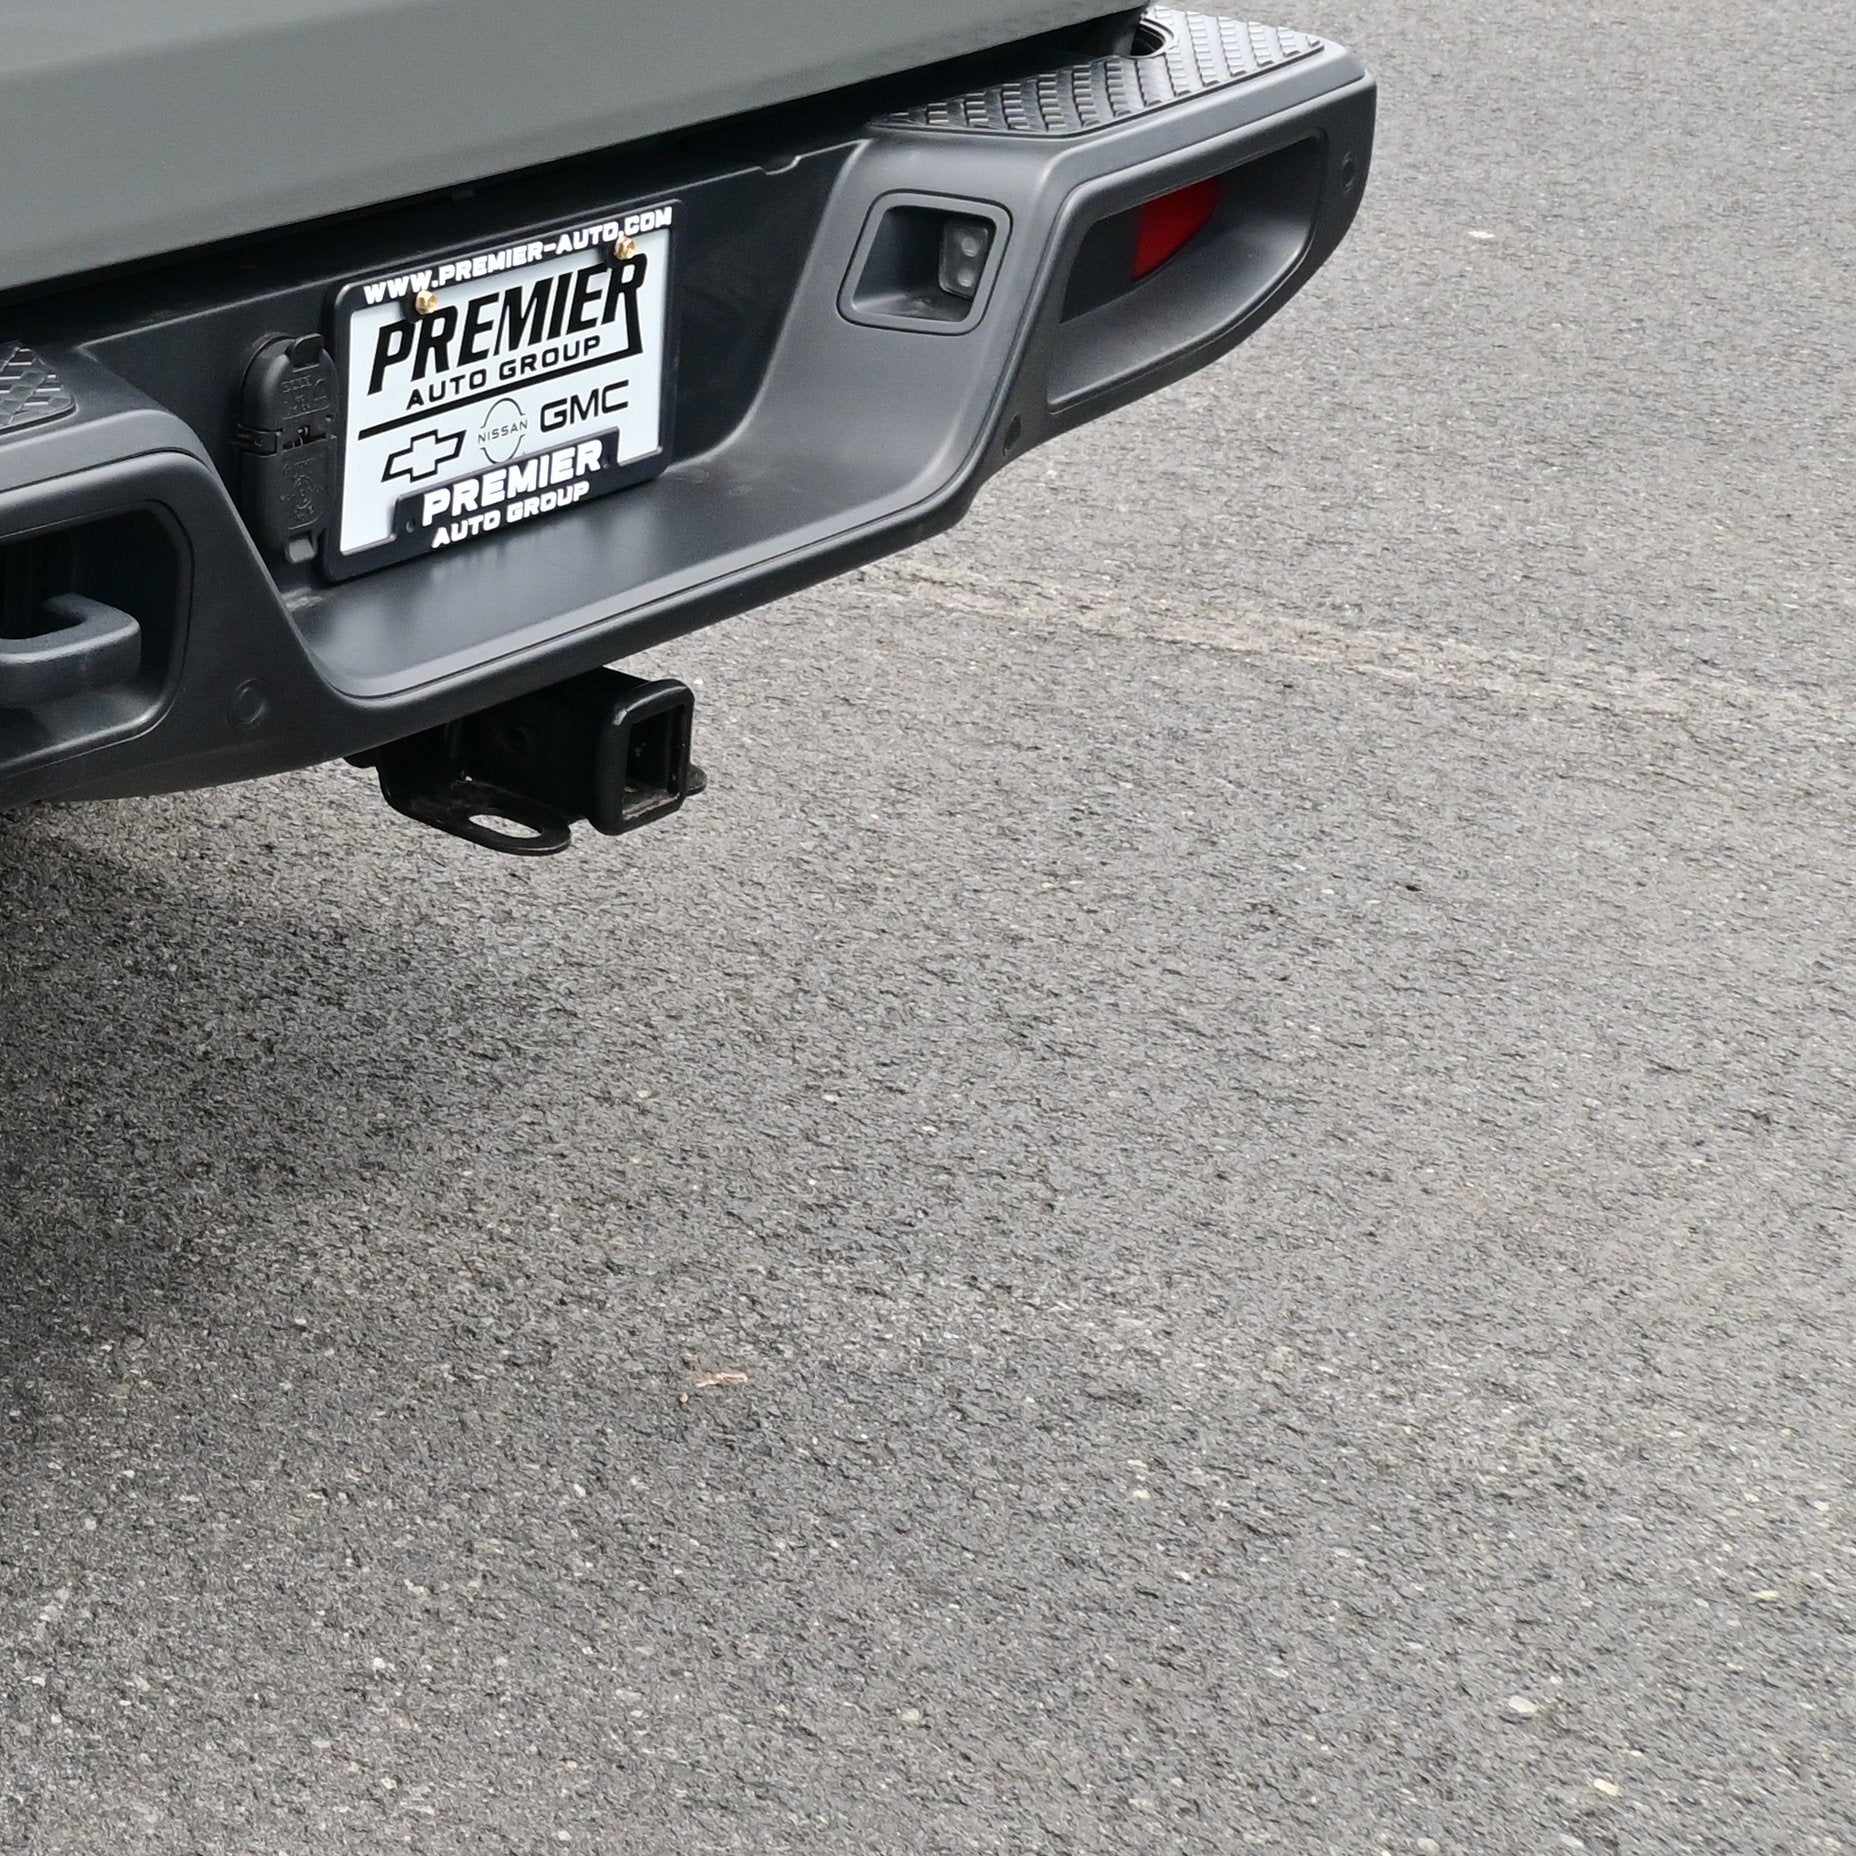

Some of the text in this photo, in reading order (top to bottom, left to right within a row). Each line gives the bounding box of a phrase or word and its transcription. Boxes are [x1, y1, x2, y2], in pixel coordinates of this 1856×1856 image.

[363, 205, 673, 305] WWW.PREMIER-AUTO.COM
[367, 252, 648, 396] PREMIER
[405, 335, 601, 411] AUTO GROUP
[539, 380, 629, 433] GMC
[477, 419, 528, 444] NISSAN
[421, 439, 605, 527] PREMIER
[431, 480, 591, 549] AUTO GROUP
